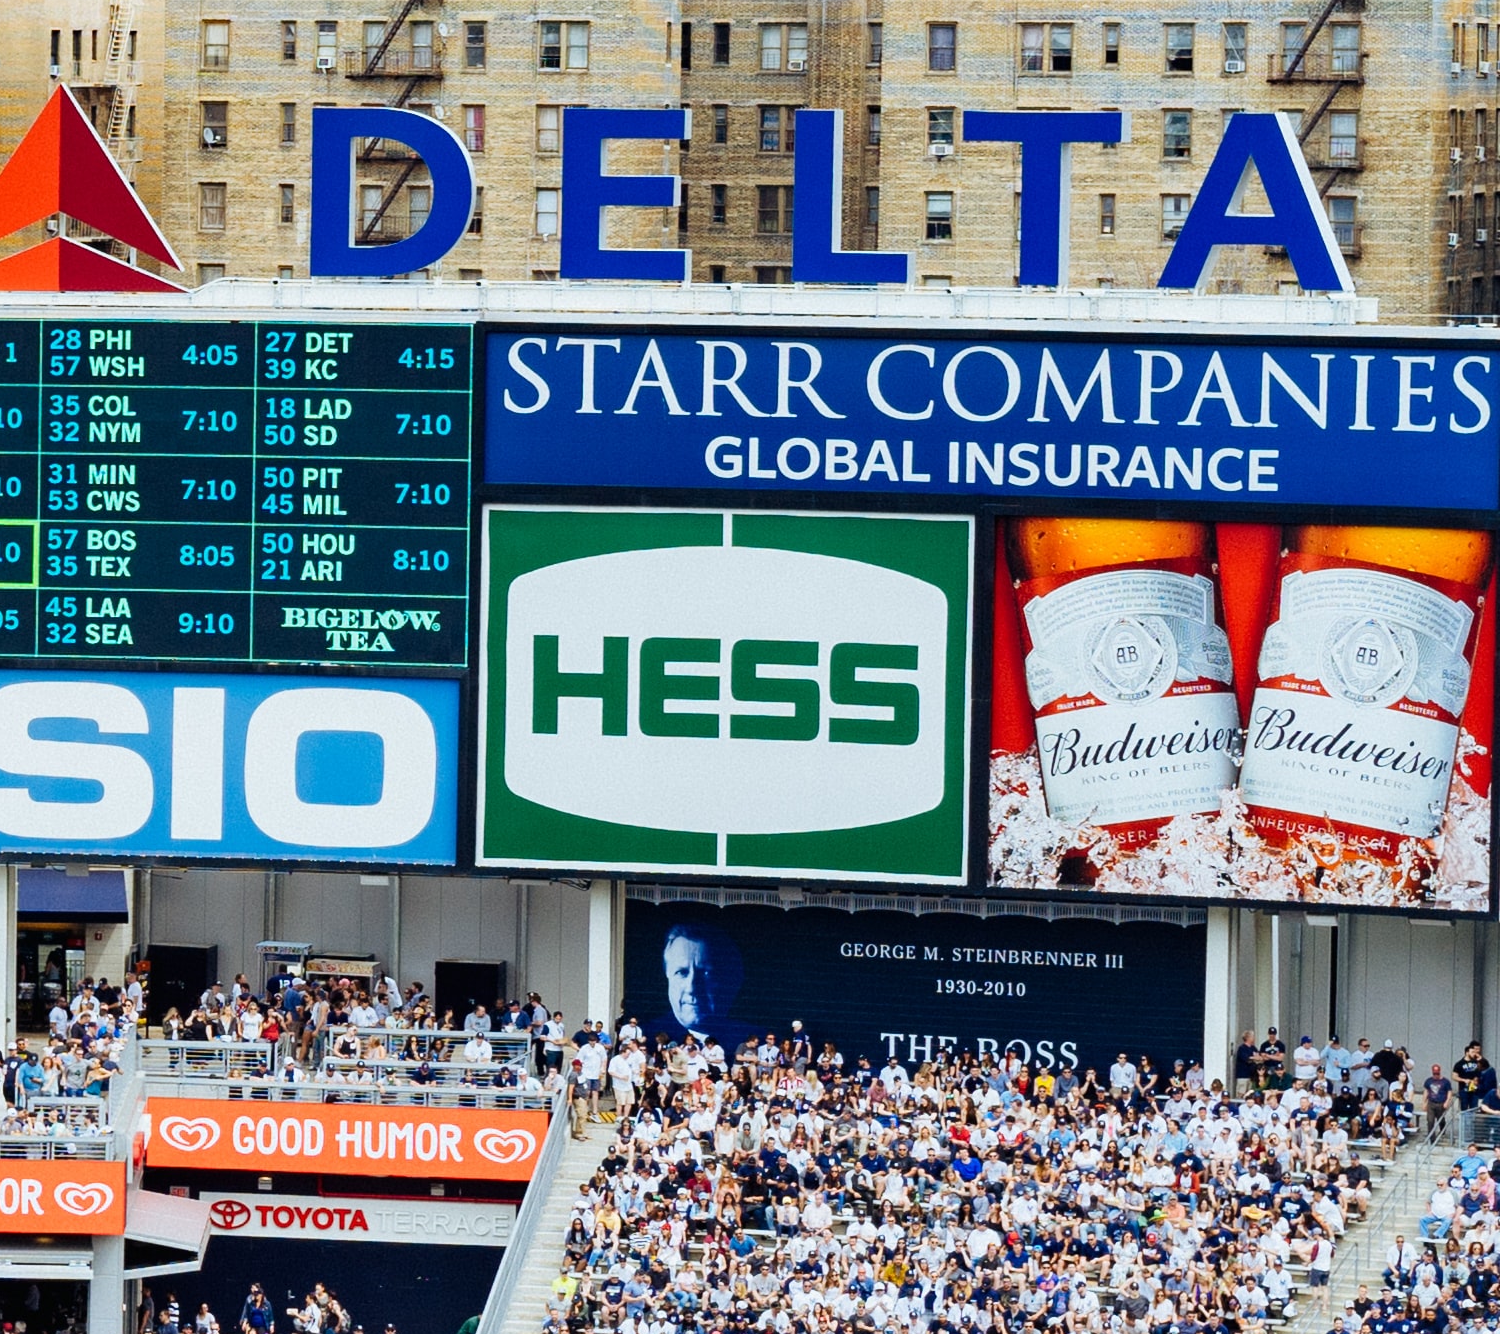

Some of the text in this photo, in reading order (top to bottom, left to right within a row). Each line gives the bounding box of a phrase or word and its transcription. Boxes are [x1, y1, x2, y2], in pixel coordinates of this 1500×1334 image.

[311, 106, 1354, 293] DELTA
[504, 337, 1490, 434] STARR COMPANIES
[705, 436, 1279, 491] GLOBAL INSURANCE
[326, 631, 395, 651] TEA
[532, 635, 919, 745] HESS
[1253, 704, 1449, 781] Budweiser
[840, 942, 1124, 970] GEORGE M. STEINBRENNER III
[937, 980, 1025, 996] 1930-2010
[233, 1116, 463, 1162] GOOD HUMOR
[255, 1206, 509, 1238] TOYOTA TERRACE
